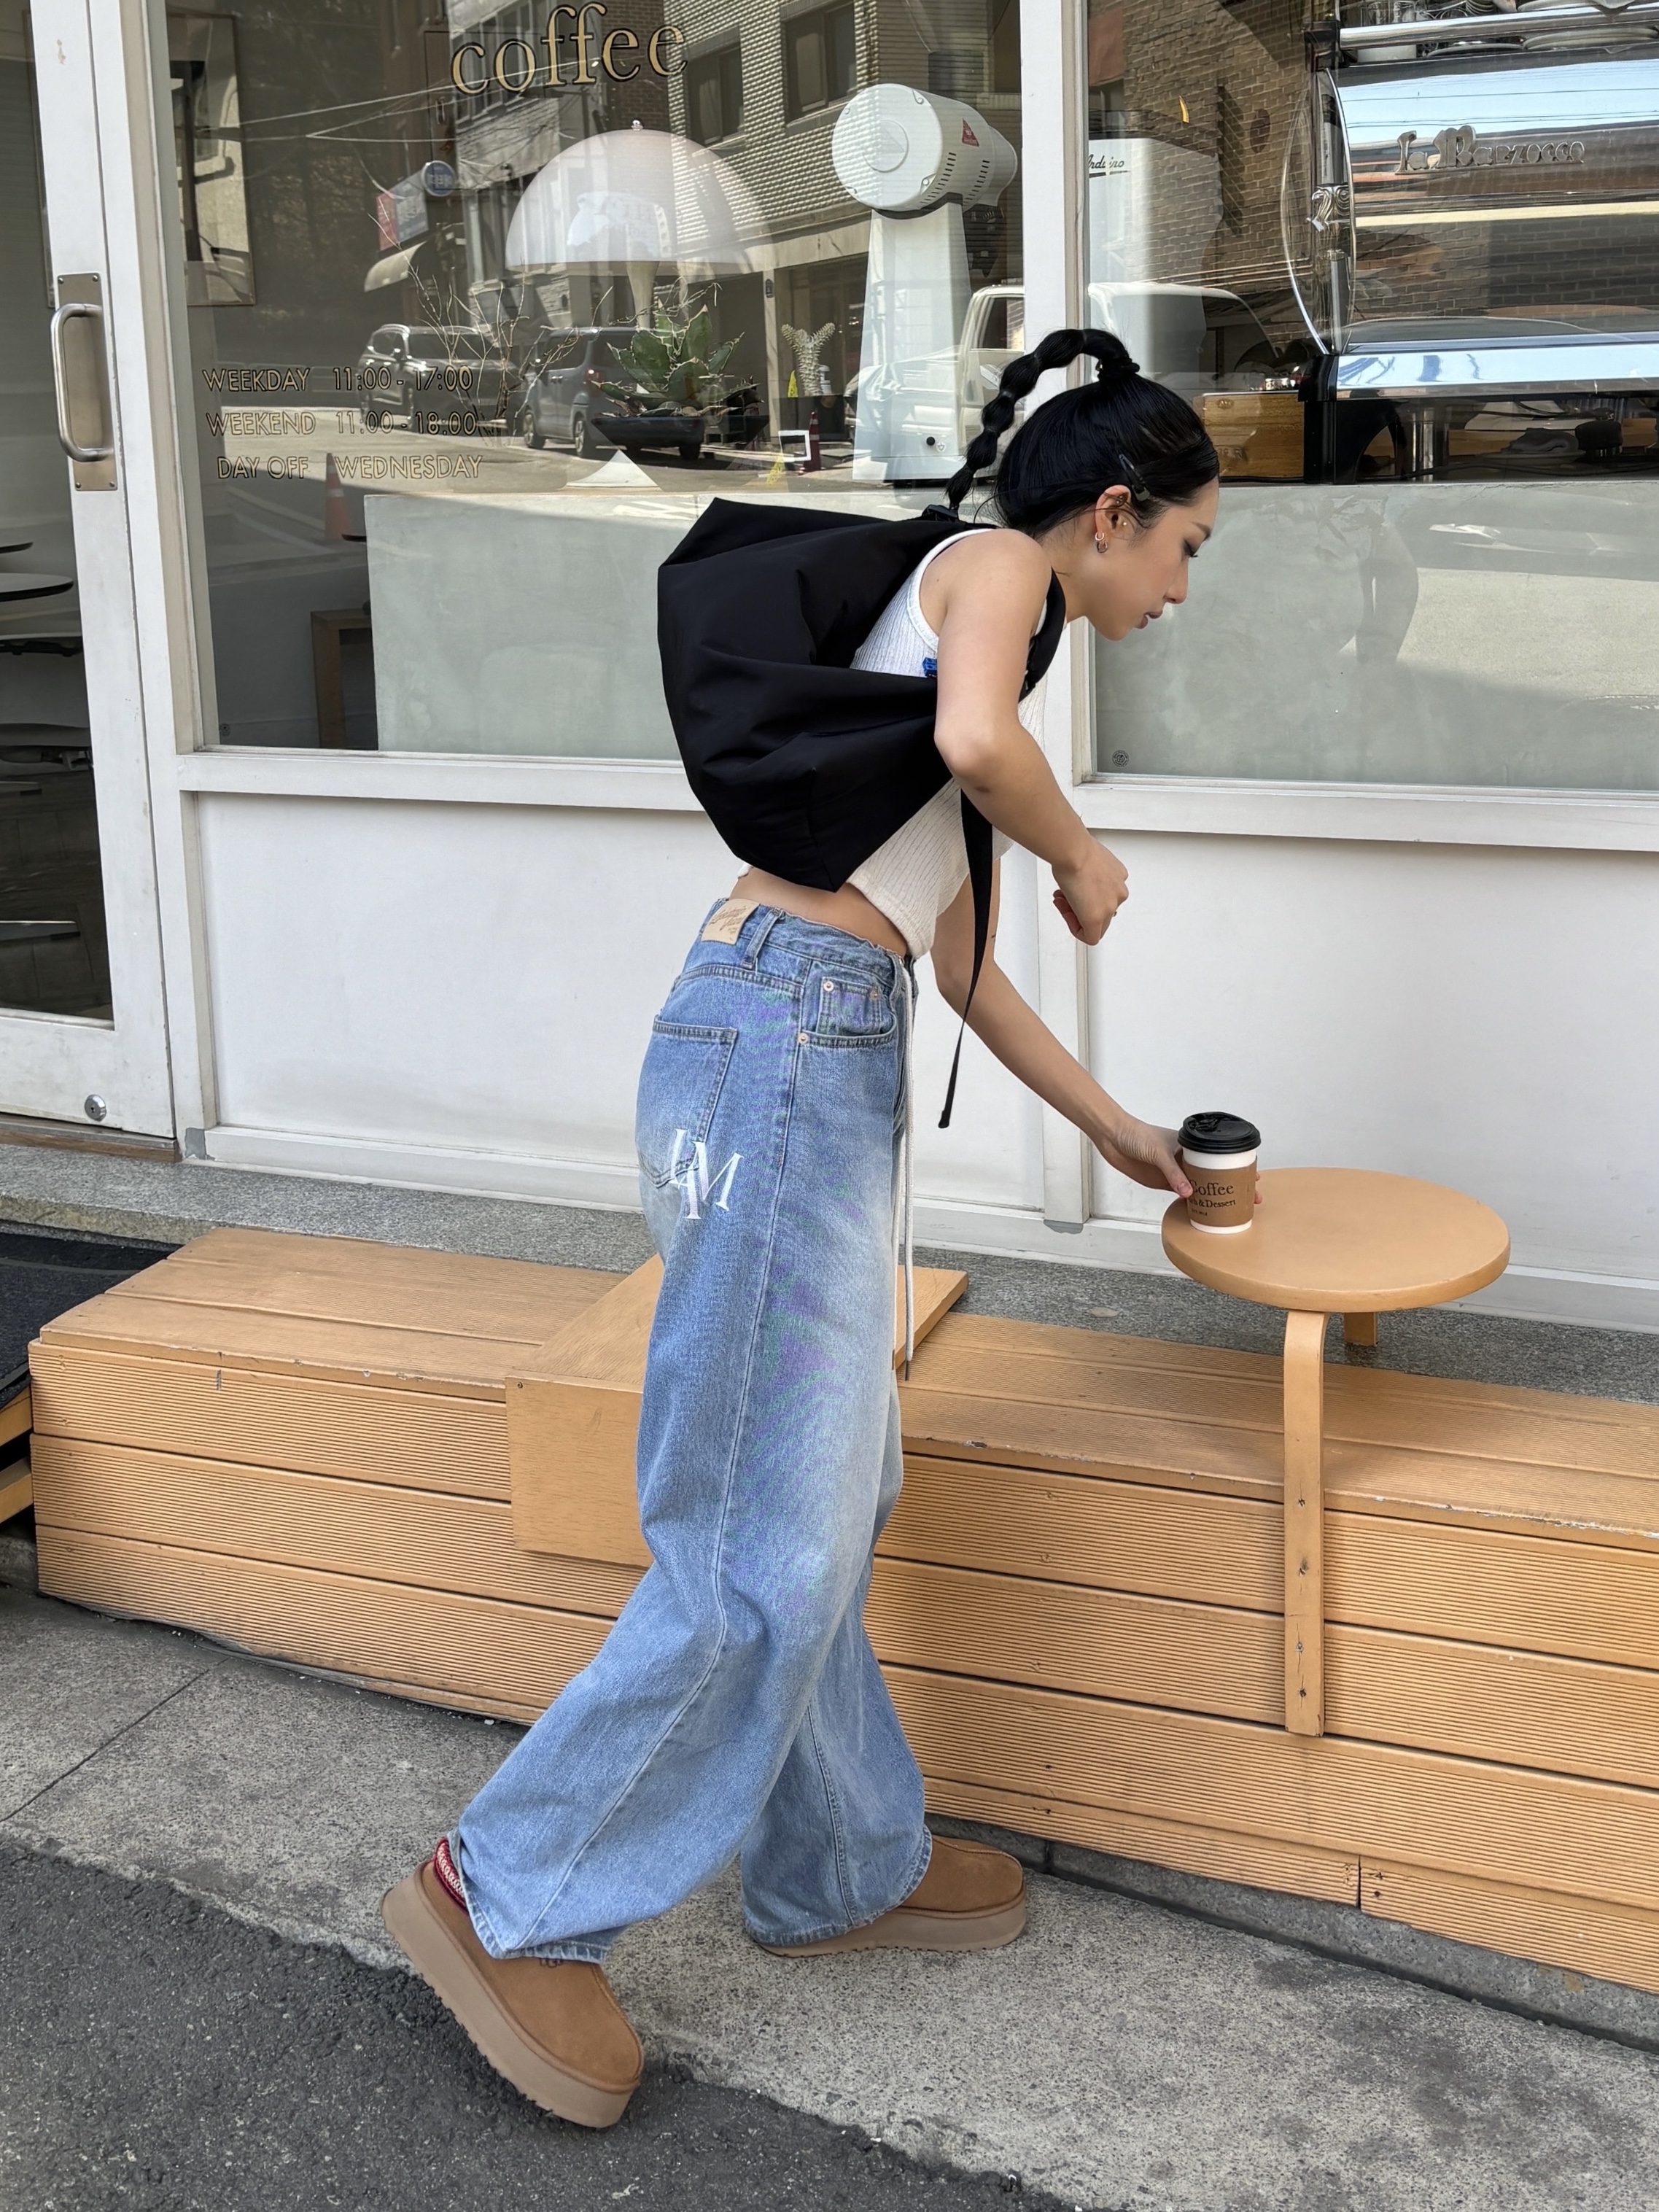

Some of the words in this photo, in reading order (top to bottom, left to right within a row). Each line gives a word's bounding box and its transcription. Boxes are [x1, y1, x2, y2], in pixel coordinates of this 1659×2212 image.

[451, 1, 688, 94] coffee
[202, 368, 310, 392] WEEKDAY
[333, 367, 392, 391] 11:00
[415, 365, 473, 391] 17:00
[206, 411, 316, 436] WEEKEND
[336, 411, 394, 434] 11:00
[416, 411, 477, 435] 18:00
[217, 456, 260, 479] DAY
[267, 456, 308, 479] OFF
[334, 454, 482, 479] WEDNESDAY
